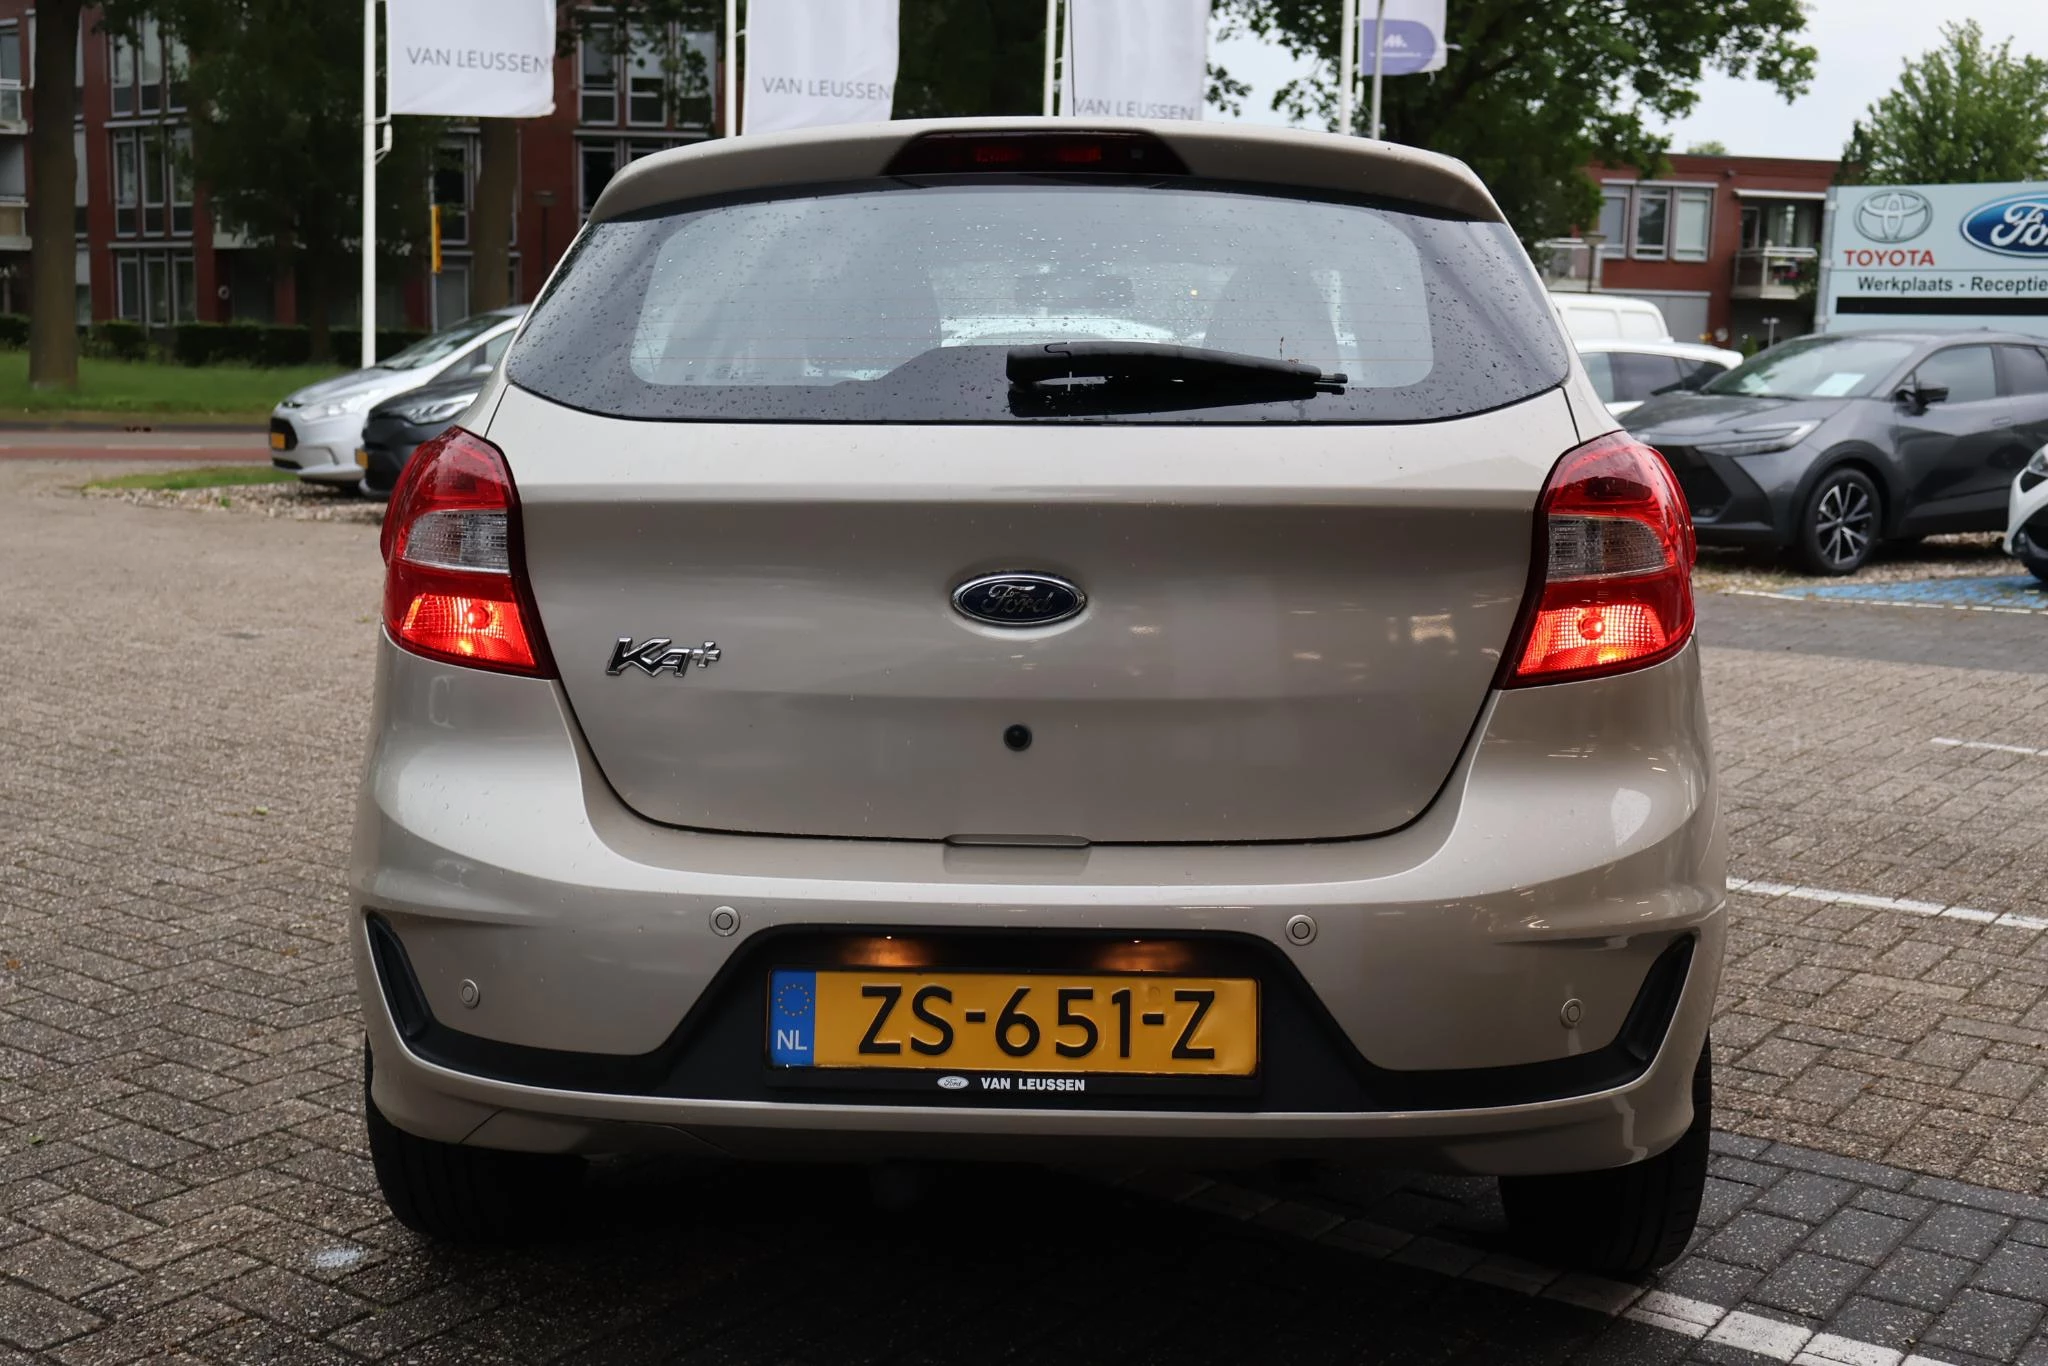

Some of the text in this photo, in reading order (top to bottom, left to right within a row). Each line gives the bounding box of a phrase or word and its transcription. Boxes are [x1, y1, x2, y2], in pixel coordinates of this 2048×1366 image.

[407, 47, 548, 73] VAN LEUSSEN
[762, 77, 890, 100] VAN LEUSSEN
[1075, 98, 1194, 120] VAN LEUSSEN
[1990, 201, 2048, 246] Fo
[1844, 250, 1935, 267] TOYOTA
[1858, 276, 1953, 293] Werkplaats
[1971, 276, 2048, 294] Receptie
[980, 583, 1055, 613] Ford
[858, 984, 1216, 1061] ZS-651-Z
[776, 1029, 808, 1052] NL
[981, 1077, 1010, 1089] VAN
[1018, 1078, 1085, 1091] LEUSSEN
